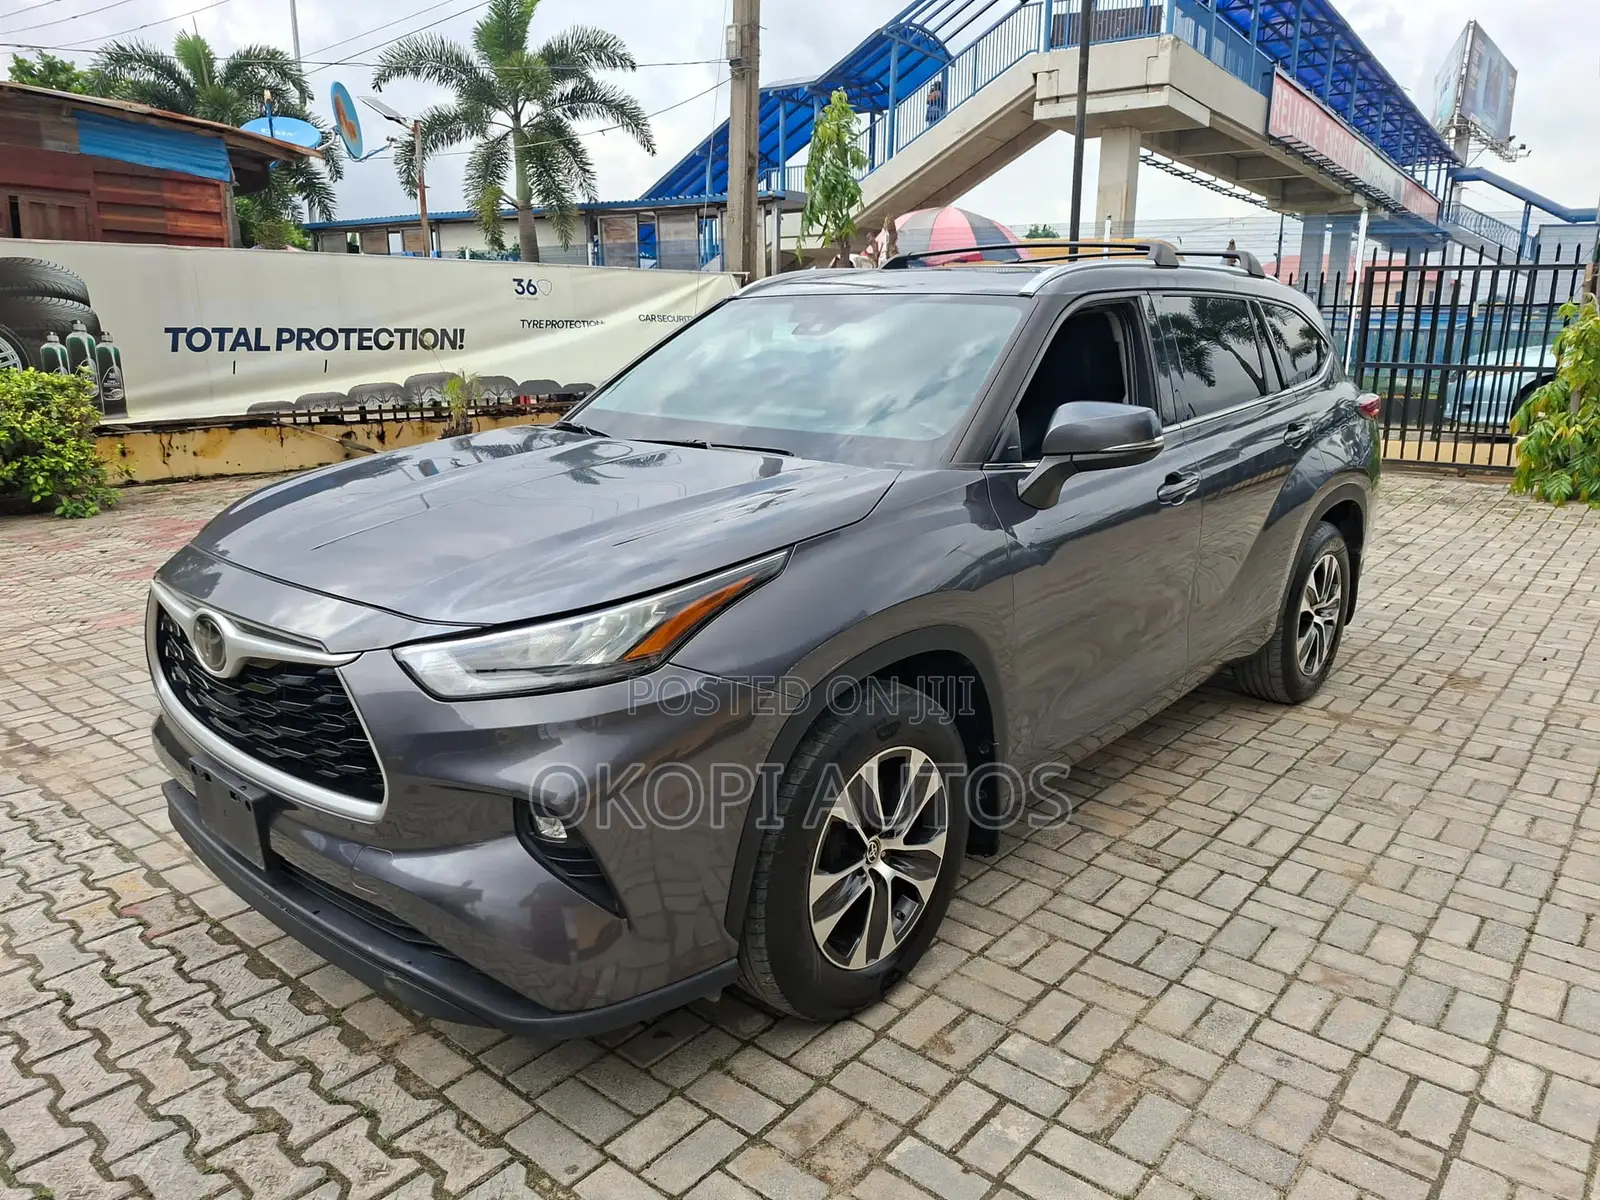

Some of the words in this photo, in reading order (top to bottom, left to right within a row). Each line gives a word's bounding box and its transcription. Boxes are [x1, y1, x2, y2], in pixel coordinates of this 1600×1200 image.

[1271, 84, 1320, 145] RELIABLE
[520, 319, 544, 329] TYRE
[638, 314, 657, 322] CAR
[657, 314, 692, 323] SECURIT
[164, 327, 271, 352] TOTAL
[276, 327, 466, 351] PROTECTION!
